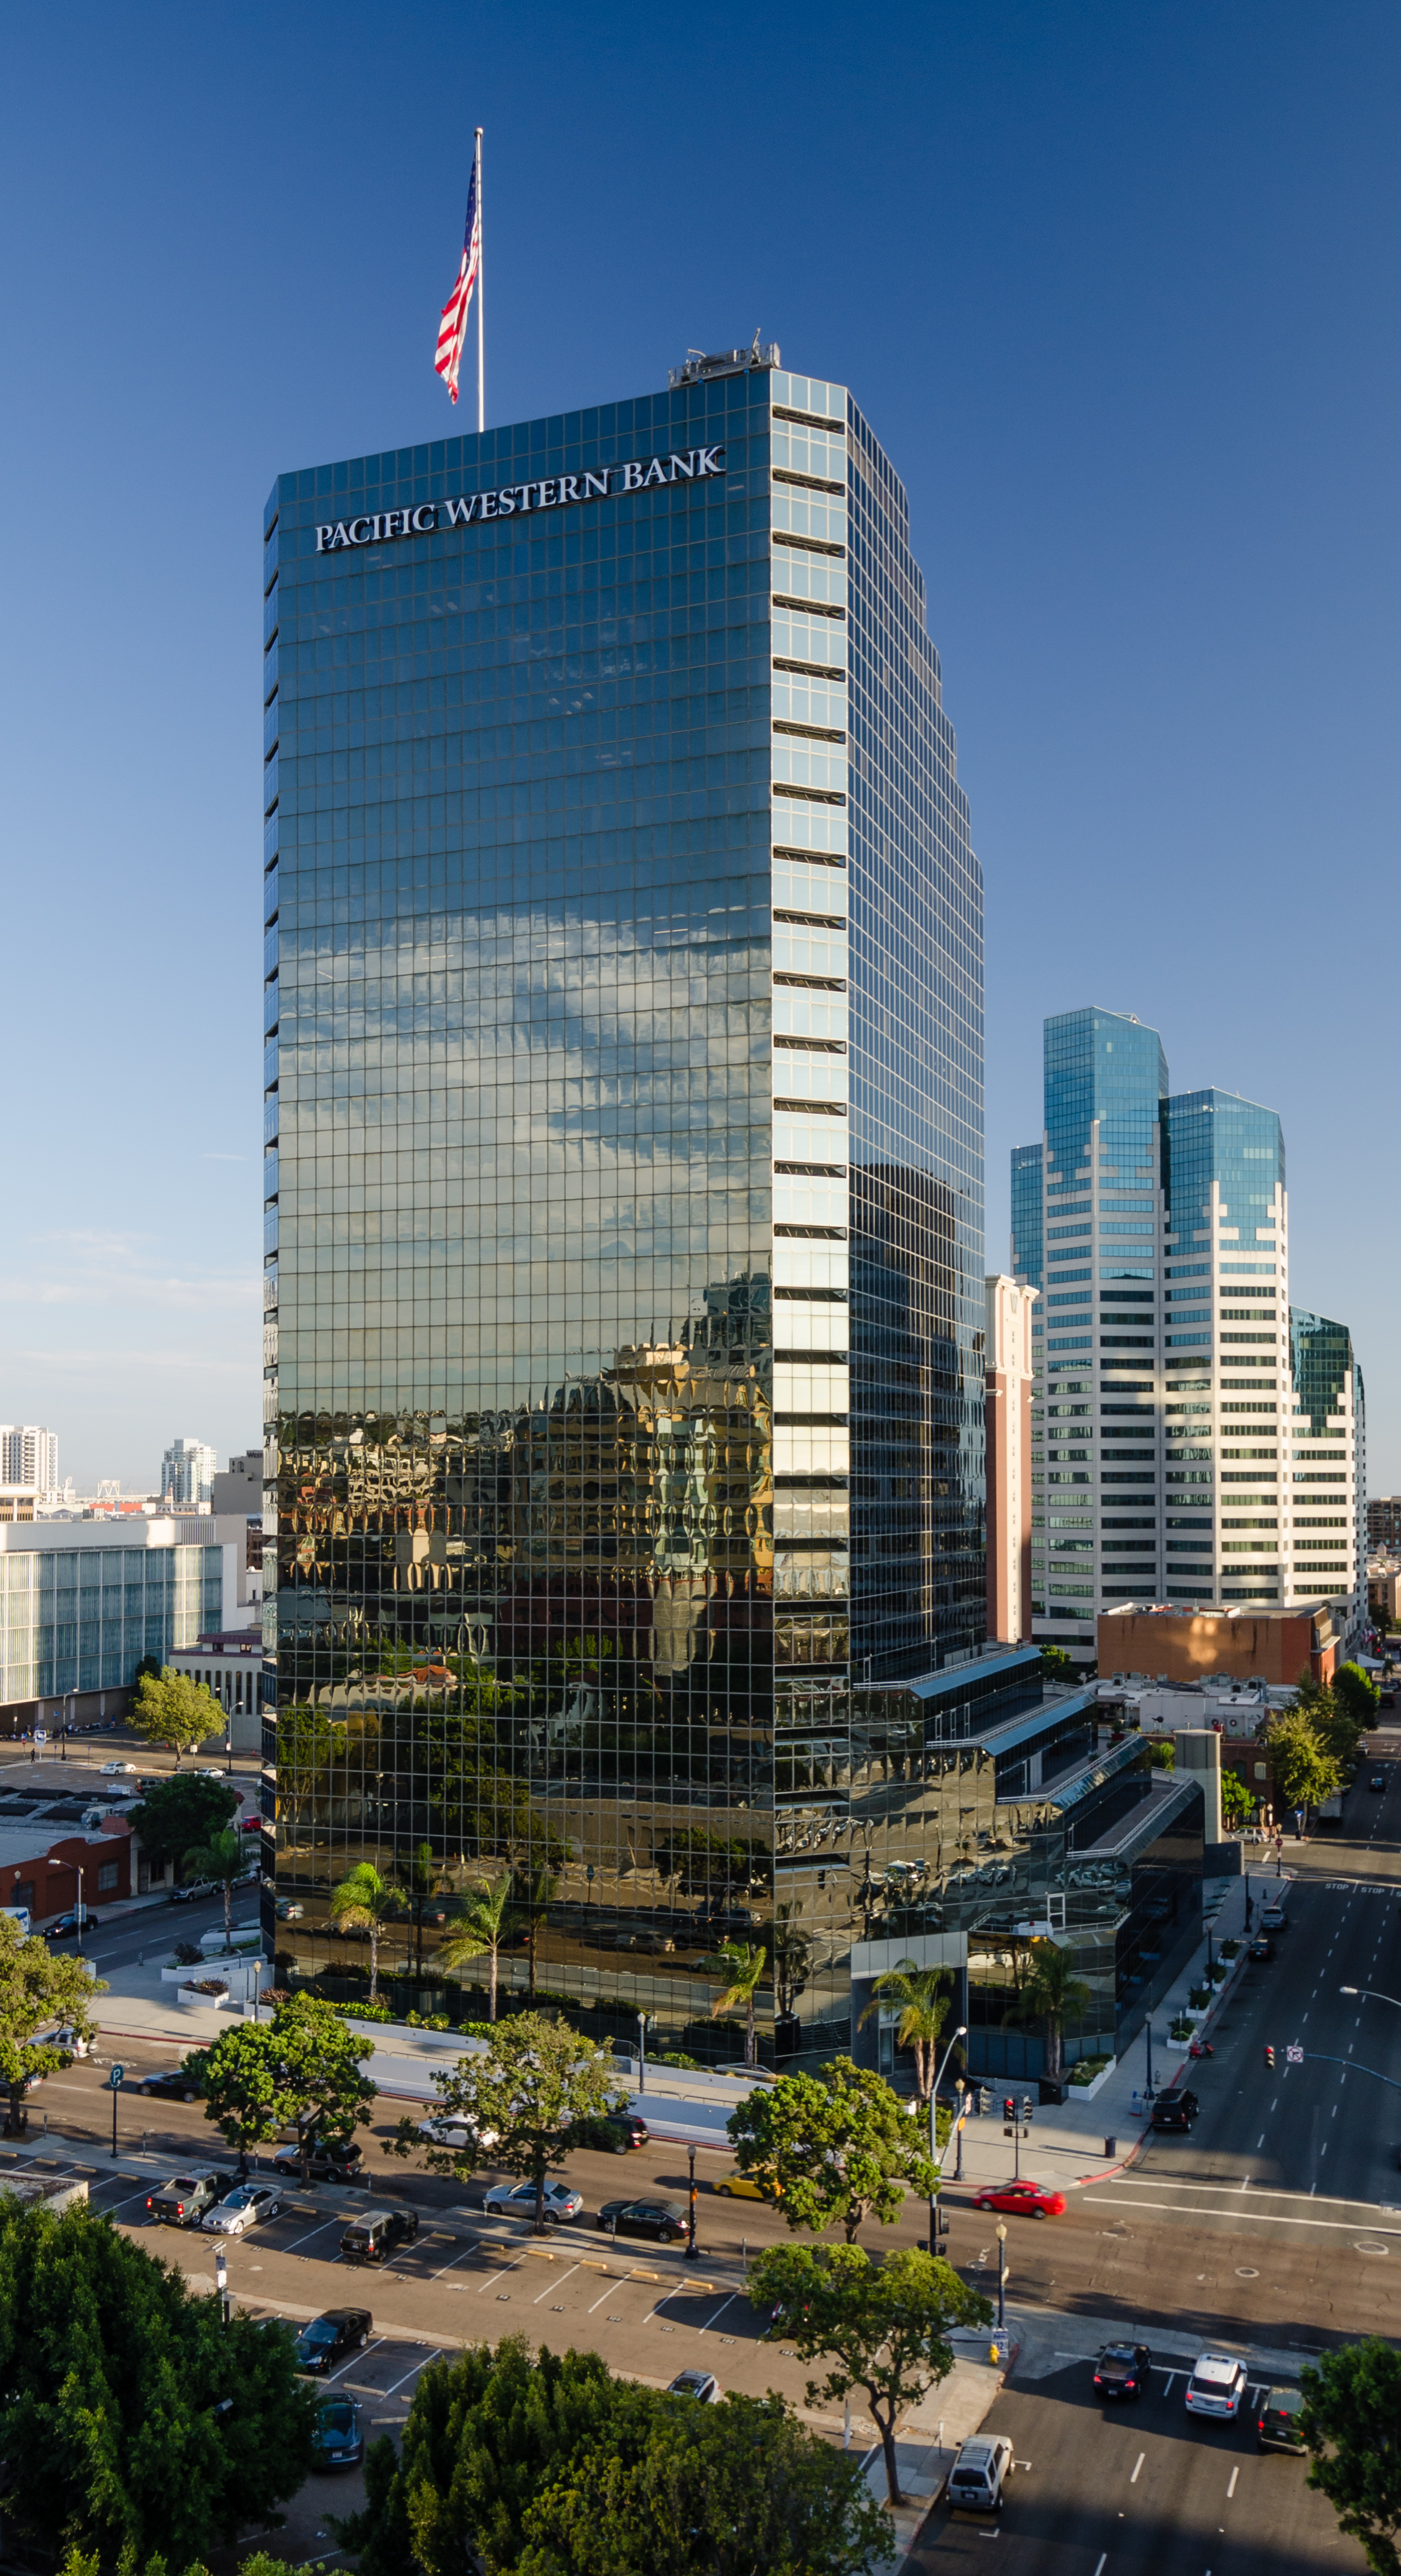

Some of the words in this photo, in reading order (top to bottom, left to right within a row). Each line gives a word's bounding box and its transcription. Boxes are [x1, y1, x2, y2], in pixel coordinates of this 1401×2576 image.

[315, 504, 435, 552] PACIFIC
[444, 468, 610, 524] WESTERN
[622, 445, 726, 491] BANK
[113, 2068, 121, 2083] P
